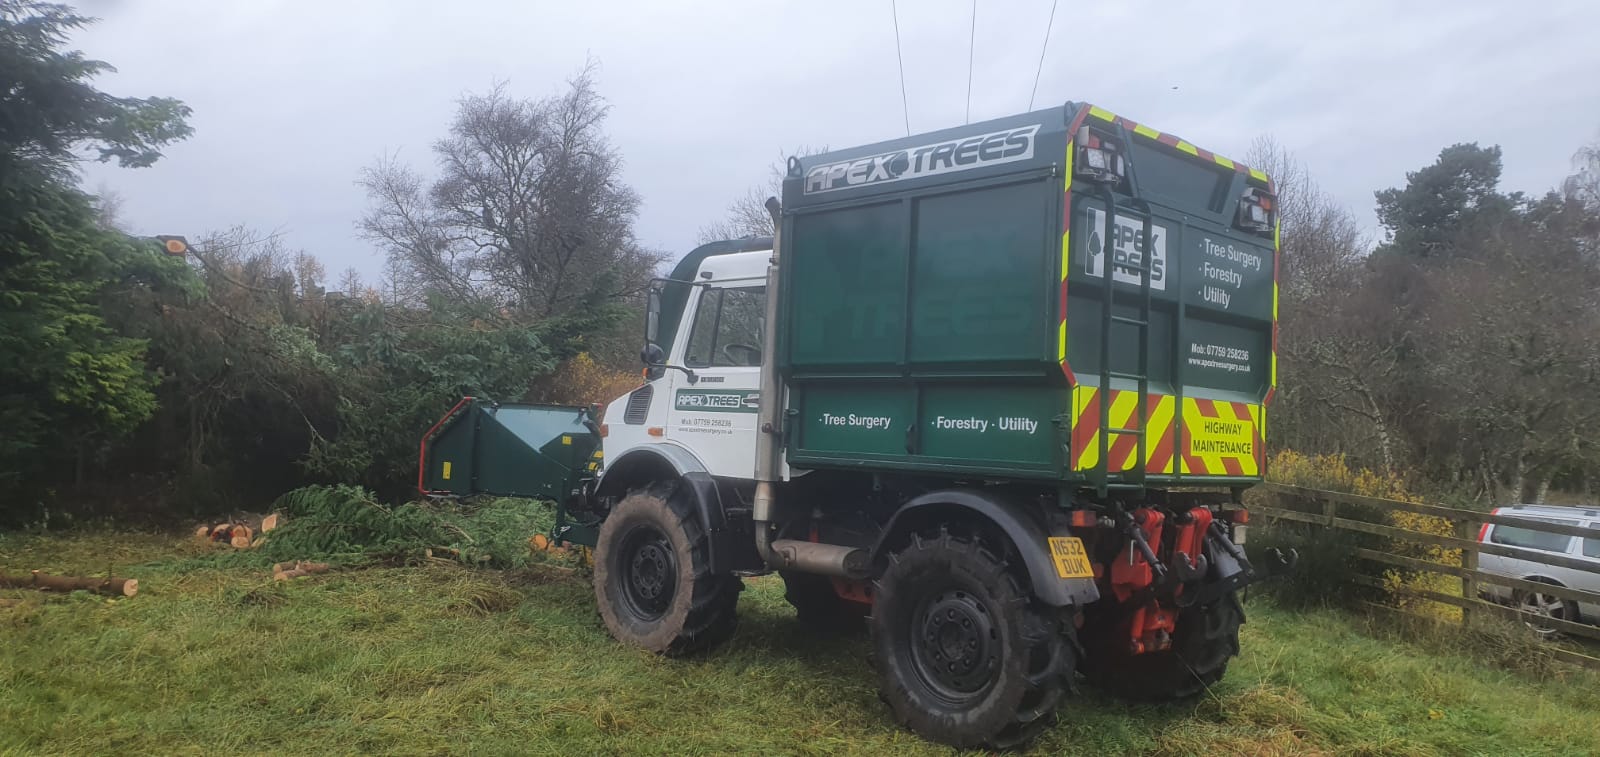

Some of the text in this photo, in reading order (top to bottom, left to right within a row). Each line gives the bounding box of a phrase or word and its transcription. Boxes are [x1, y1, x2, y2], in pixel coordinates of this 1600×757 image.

[806, 127, 1037, 192] APEX TREES
[1204, 238, 1262, 271] Tree Surgery
[1204, 262, 1243, 288] Forestry
[1203, 285, 1231, 310] Utility
[1191, 343, 1249, 361] Mob: 07759 258236
[678, 394, 740, 407] APEX TREES
[823, 413, 891, 429] Tree Surgery
[936, 416, 1038, 434] Forestry Utility
[1204, 421, 1242, 436] HIGHWAY
[1193, 439, 1251, 454] MAINTENANCE
[1051, 539, 1083, 556] N632
[1061, 558, 1087, 575] DUK
